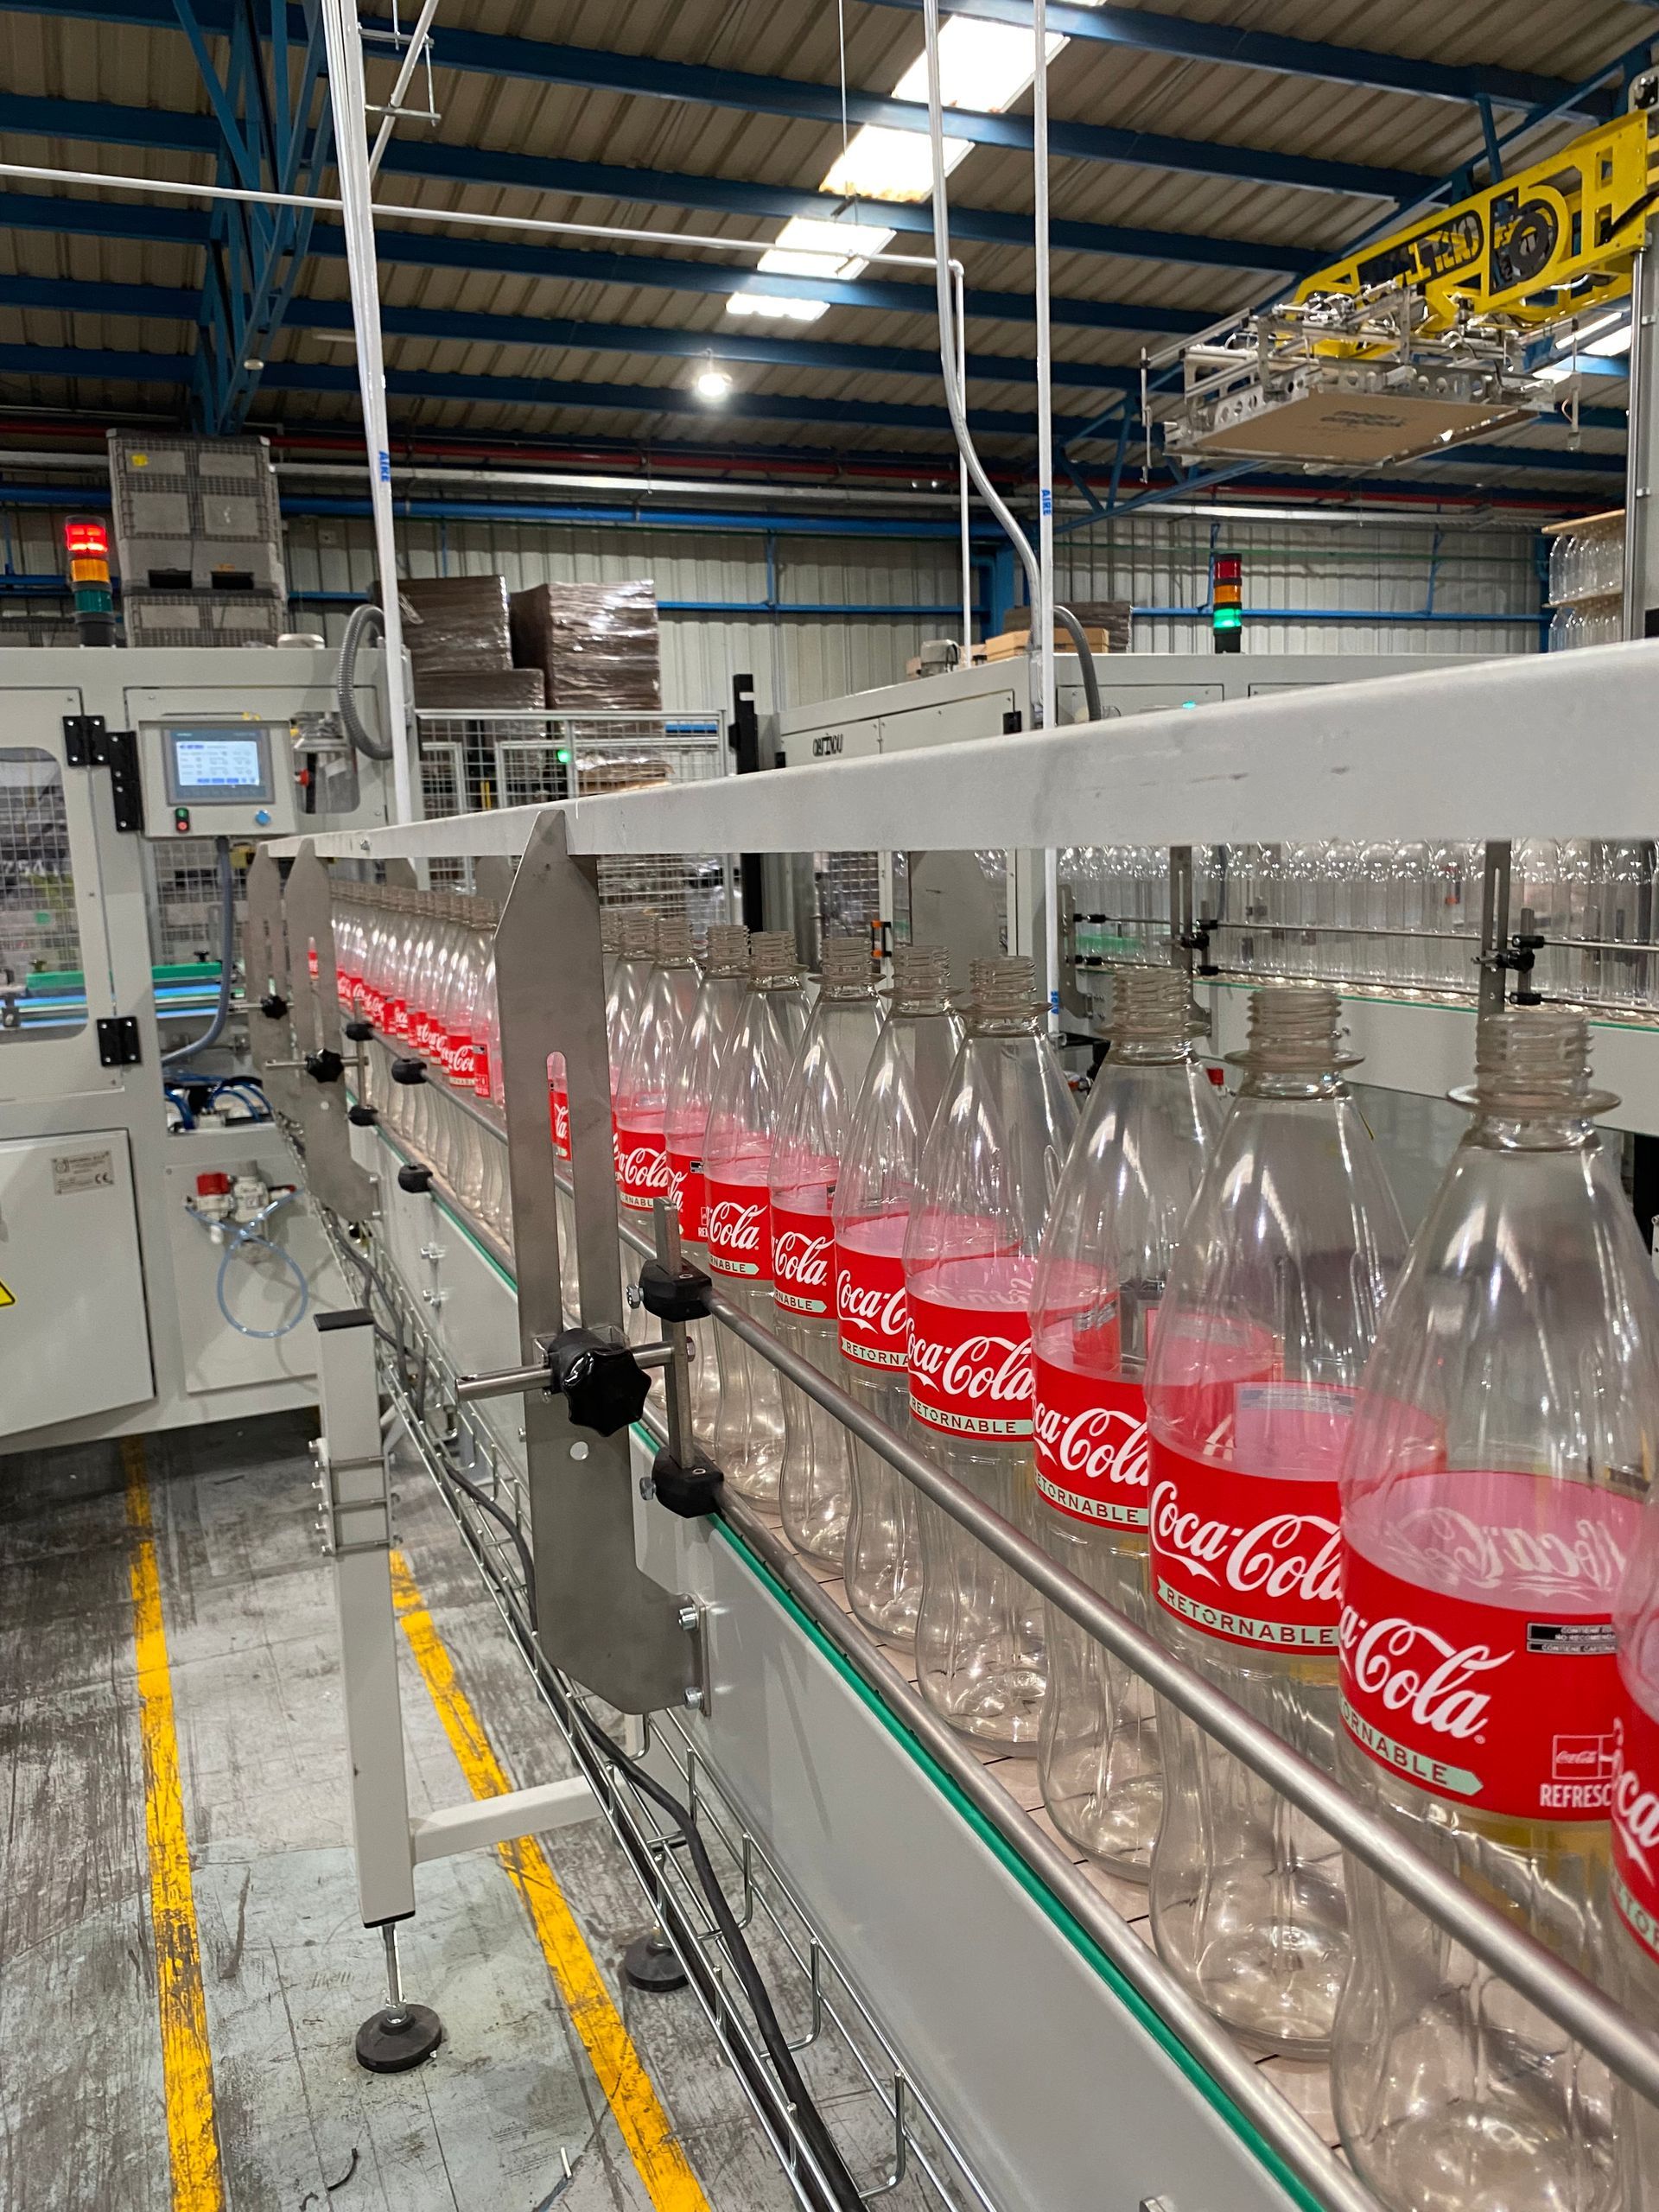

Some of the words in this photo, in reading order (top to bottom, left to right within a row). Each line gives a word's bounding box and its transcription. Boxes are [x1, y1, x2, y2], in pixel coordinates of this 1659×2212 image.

[379, 450, 391, 482] AIRE
[1041, 489, 1051, 516] AIRE
[619, 1147, 668, 1188] a-Cola
[709, 1201, 768, 1249] -Cola
[774, 1231, 835, 1285] -Cola
[837, 1269, 907, 1335] Coca-C
[847, 1341, 909, 1365] RETORNA
[912, 1398, 1017, 1433] RETORNABLE
[1034, 1402, 1148, 1486] ca-Cola
[1036, 1474, 1139, 1523] ETORNABLE
[1166, 1588, 1333, 1644] RETORNABLE
[1339, 1605, 1516, 1738] a-Cola
[1341, 1698, 1448, 1785] ORNABLE
[1540, 1783, 1611, 1808] REFRESC
